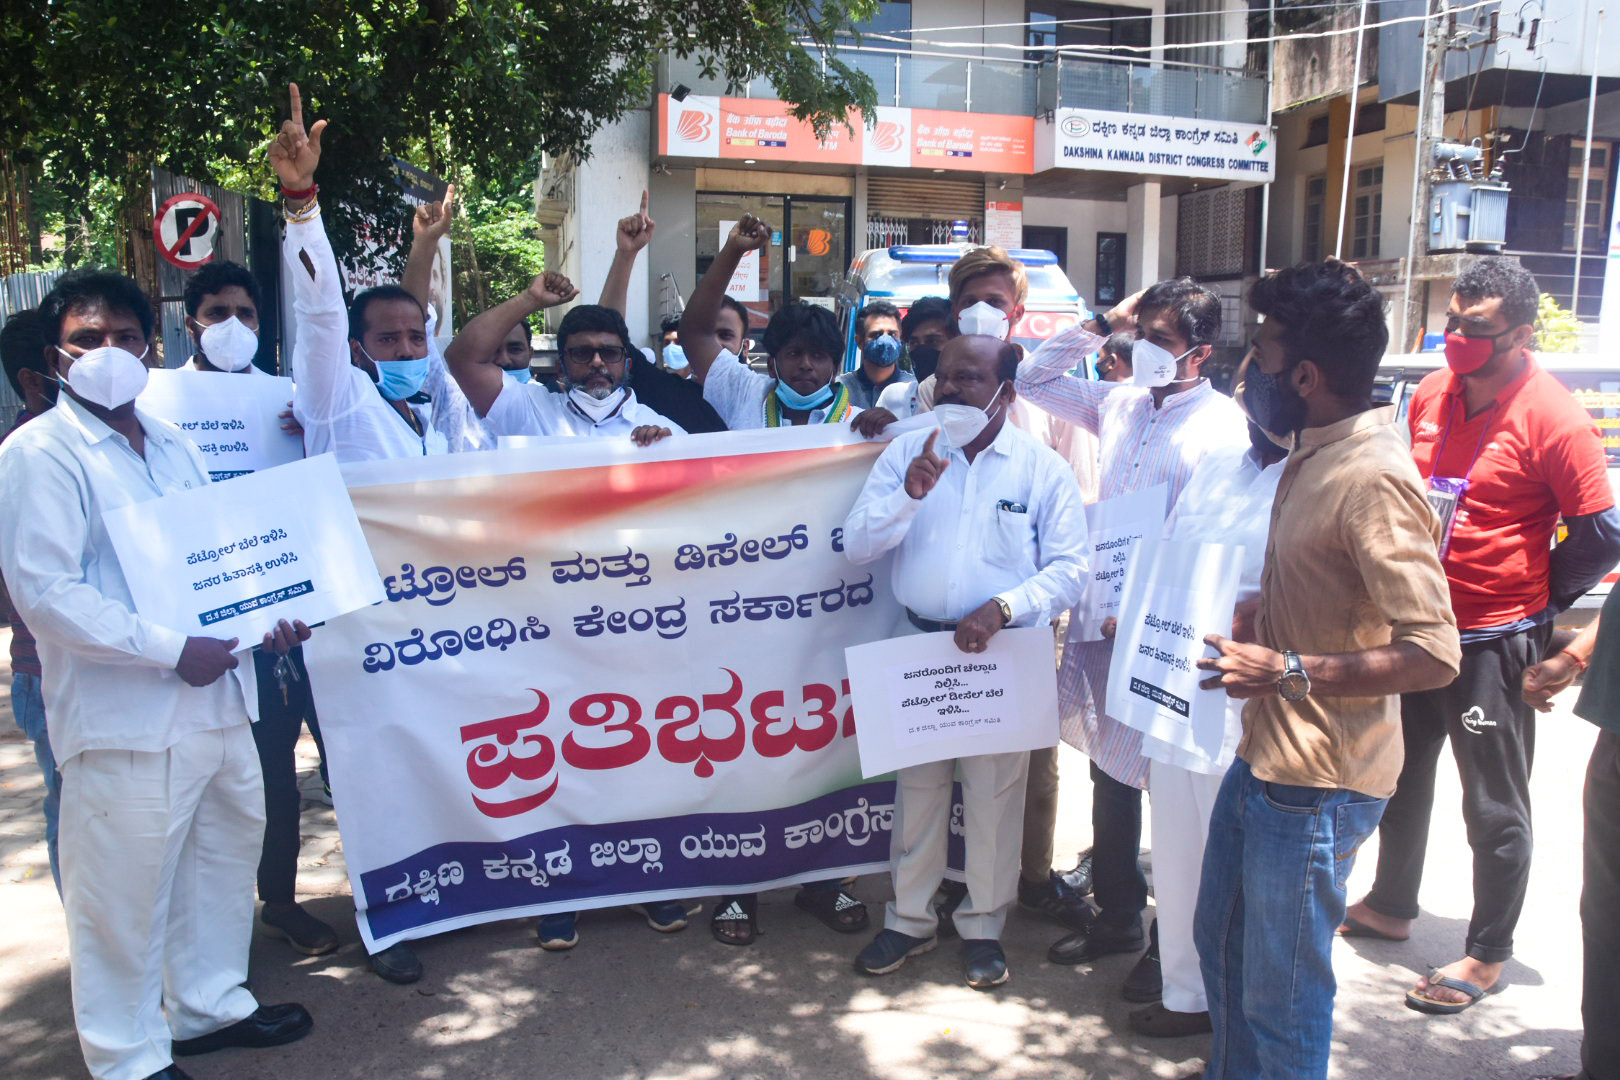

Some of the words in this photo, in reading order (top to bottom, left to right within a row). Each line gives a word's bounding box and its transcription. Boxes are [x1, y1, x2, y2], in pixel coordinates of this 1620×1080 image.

[726, 127, 748, 138] Bank
[749, 128, 758, 138] of
[758, 129, 788, 140] Baroda
[917, 137, 937, 148] Bank
[938, 139, 946, 148] of
[946, 140, 973, 150] Baroda
[1092, 121, 1117, 138] ದಕ್ಷಿಣ
[1122, 123, 1146, 141] ಕನ್ನಡ
[1150, 126, 1172, 142] ಜಿಲ್ಲಾ
[1214, 131, 1238, 145] ಸಮಿತಿ
[1063, 146, 1103, 160] DAKSHINA
[1107, 149, 1145, 163] KANNADA
[1149, 152, 1182, 166] DISTRICT
[1186, 156, 1225, 169] CONGRESS
[1228, 159, 1269, 172] COMMITTEE
[174, 207, 210, 256] P
[730, 284, 746, 292] ATM
[201, 420, 219, 430] ಬೆಲೆ
[221, 419, 245, 430] ಇಳಿಸಿ
[220, 441, 249, 452] ಉಳಿಸಿ
[186, 542, 236, 565] ಪೆಟ್ರೋಲ್
[239, 536, 259, 551] ಬೆಲೆ
[260, 528, 288, 544] ಇಳಿಸಿ
[192, 574, 221, 591] ಜನರ
[223, 562, 266, 583] ಹಿತಾಸಕ್ತಿ
[265, 552, 298, 570] ಉಳಿಸಿ
[380, 556, 527, 606] ಟ್ರೋಲ್
[551, 545, 651, 587] ಮತ್ತು
[674, 524, 809, 571] ಡಿಸೇಲ್
[362, 616, 550, 673] ವಿರೋಧಿಸಿ
[573, 595, 687, 640] ಕೇಂದ್ರ
[709, 572, 874, 625] ಸರ್ಕಾರದ
[904, 664, 961, 680] ಜನರೊಂದಿಗೆ
[963, 663, 997, 674] ಚೆಲ್ಲಾಟ
[901, 693, 947, 707] ಪೆಟ್ರೋಲ್
[985, 688, 1004, 698] ಬೆಲೆ
[460, 667, 858, 819] ಪ್ರತಿಭಟ
[482, 840, 573, 887] ಕನ್ನಡ
[590, 837, 664, 874] ಜಿಲ್ಲಾ
[680, 824, 766, 859] ಯುವ
[715, 912, 749, 921] adidas
